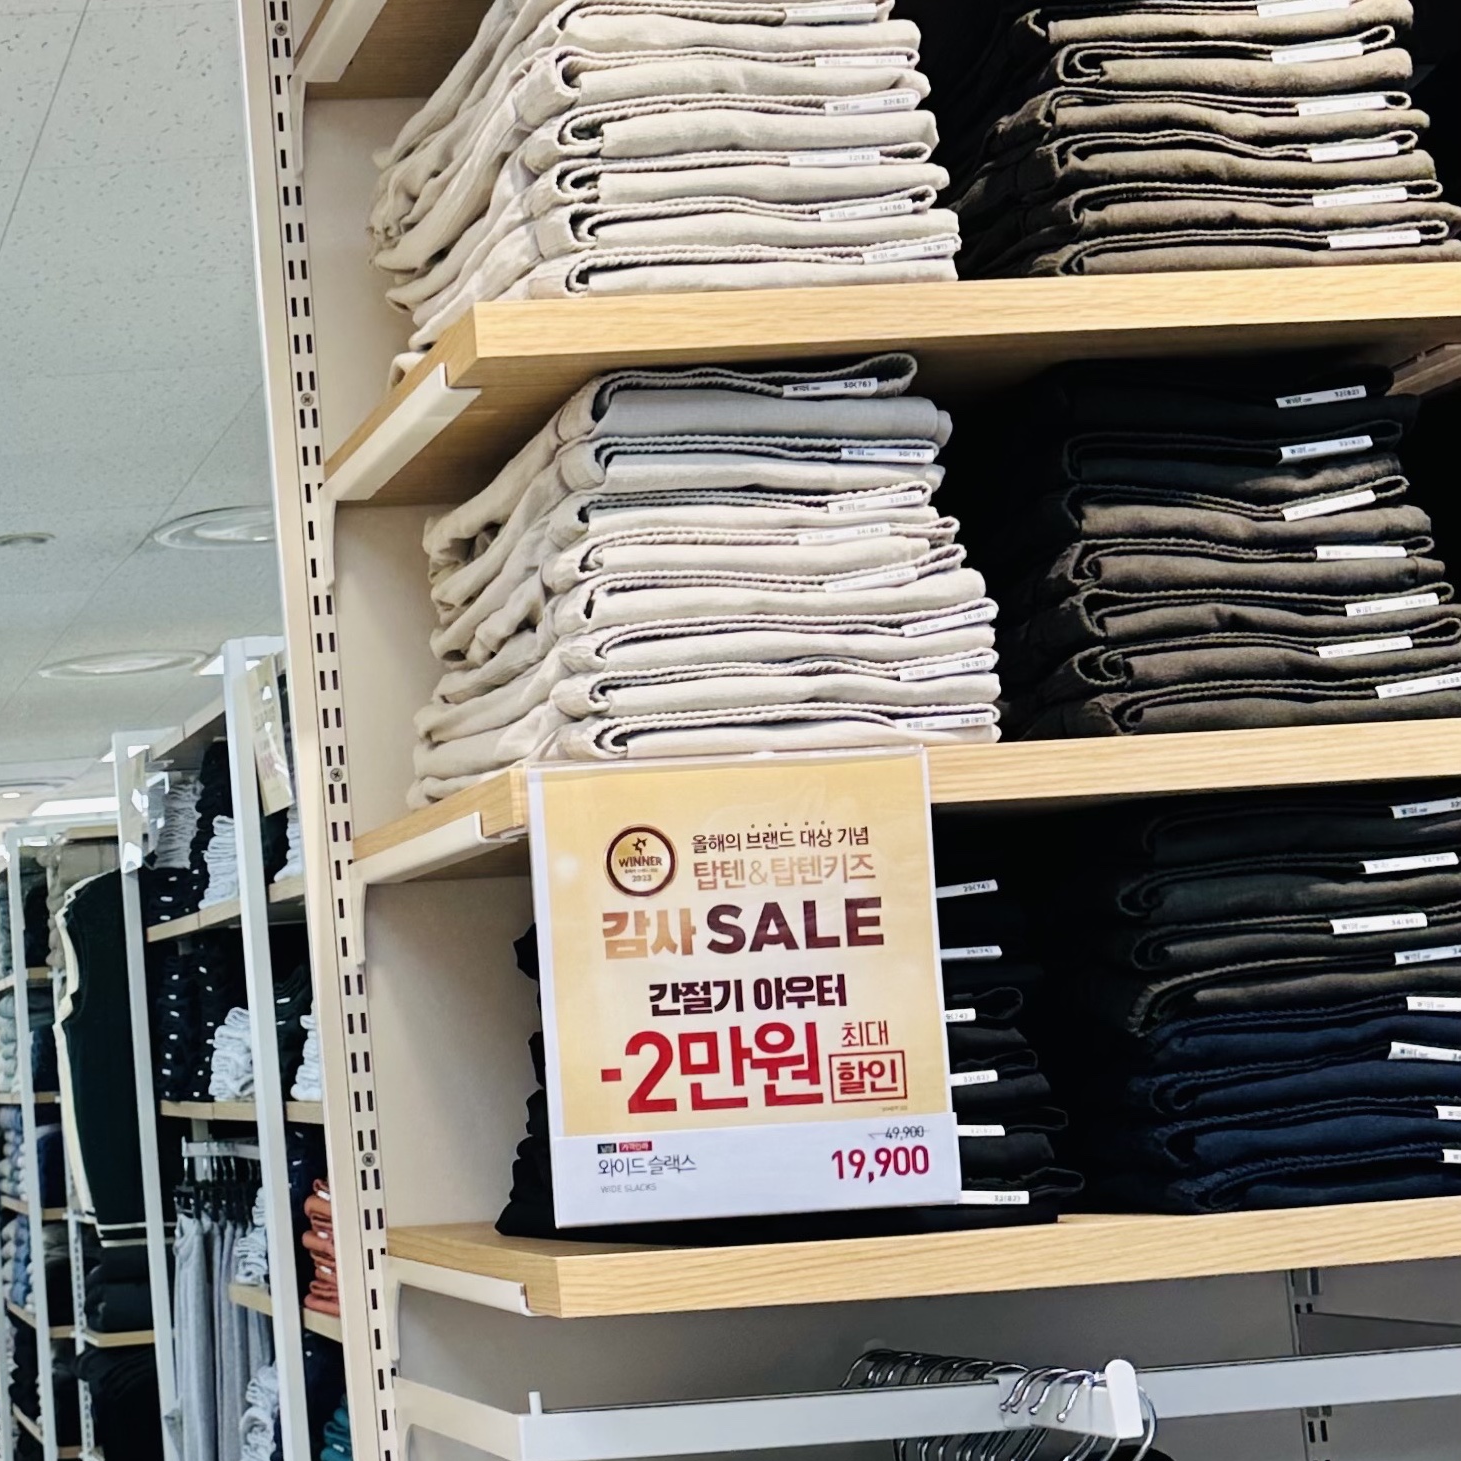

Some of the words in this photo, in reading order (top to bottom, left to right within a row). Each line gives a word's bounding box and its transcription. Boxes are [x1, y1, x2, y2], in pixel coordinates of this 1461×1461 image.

[691, 834, 741, 854] 올해의
[746, 830, 796, 849] 브랜드
[800, 827, 832, 848] 대상
[838, 826, 869, 846] 기념
[618, 855, 663, 867] WINNER
[693, 853, 876, 891] 탑텐&탑텐키즈
[602, 907, 697, 960] 감사
[706, 896, 885, 955] SALE
[649, 979, 744, 1016] 간절기
[753, 974, 847, 1010] 아우터
[601, 1021, 824, 1114] -2만원
[841, 1020, 889, 1048] 최대
[836, 1059, 898, 1095] 할인
[885, 1125, 925, 1141] 49,900
[831, 1144, 929, 1184] 19,900
